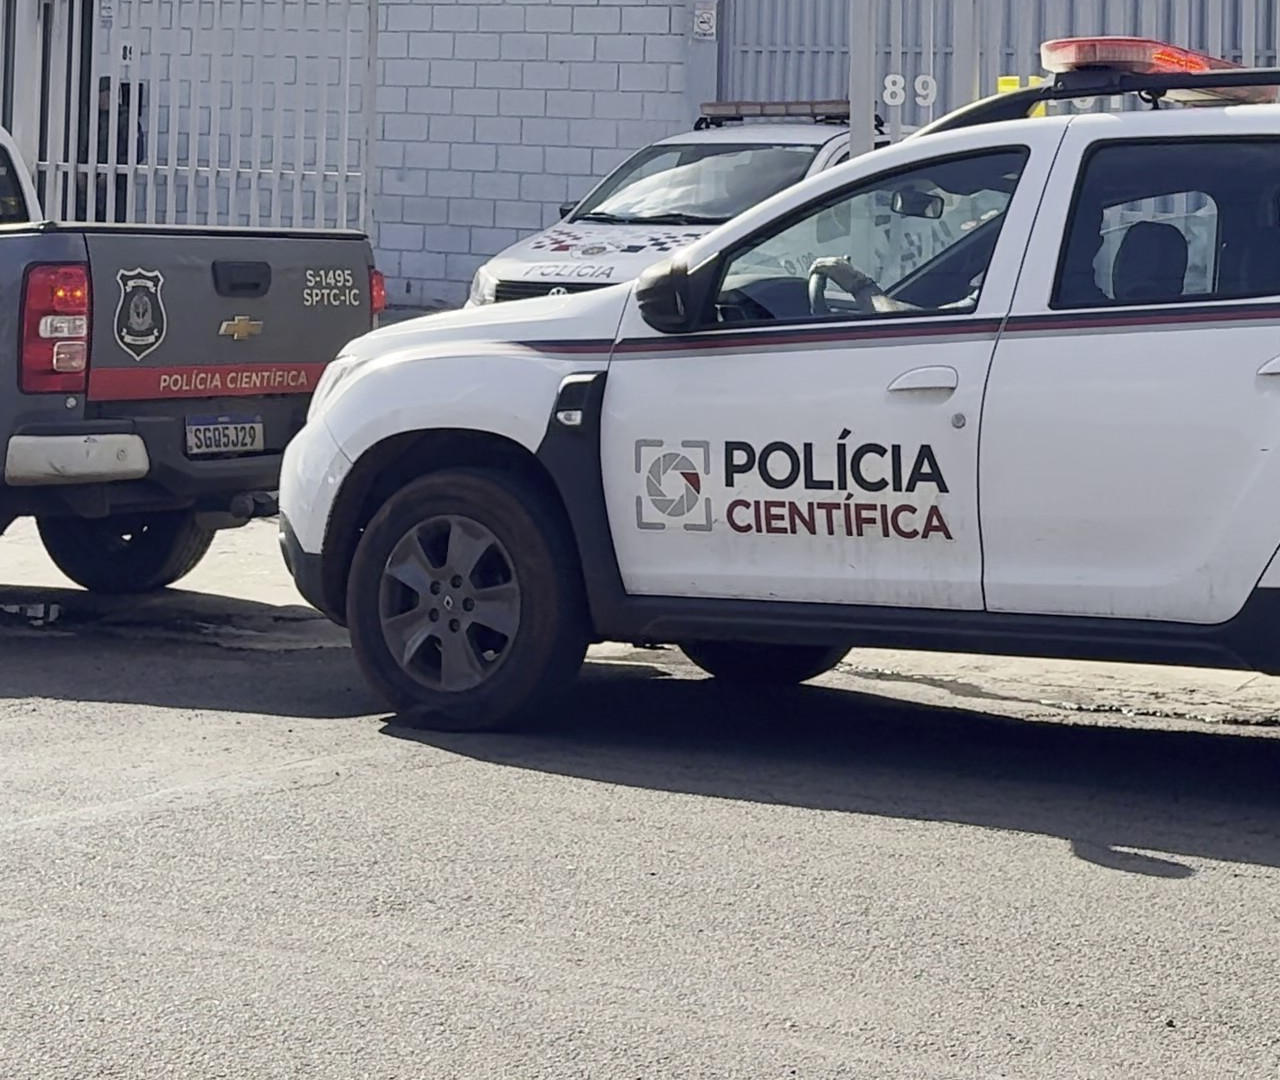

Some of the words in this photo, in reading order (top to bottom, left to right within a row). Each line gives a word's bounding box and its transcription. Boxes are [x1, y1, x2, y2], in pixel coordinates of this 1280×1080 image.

[883, 74, 937, 107] 89
[305, 269, 353, 287] S-1495
[303, 288, 360, 306] SPTC-IC
[159, 370, 221, 391] POLÍCIA
[226, 368, 308, 389] CIENTÍFICA
[724, 428, 950, 494] POLÍCIA
[726, 492, 954, 541] CIENTÍFICA
